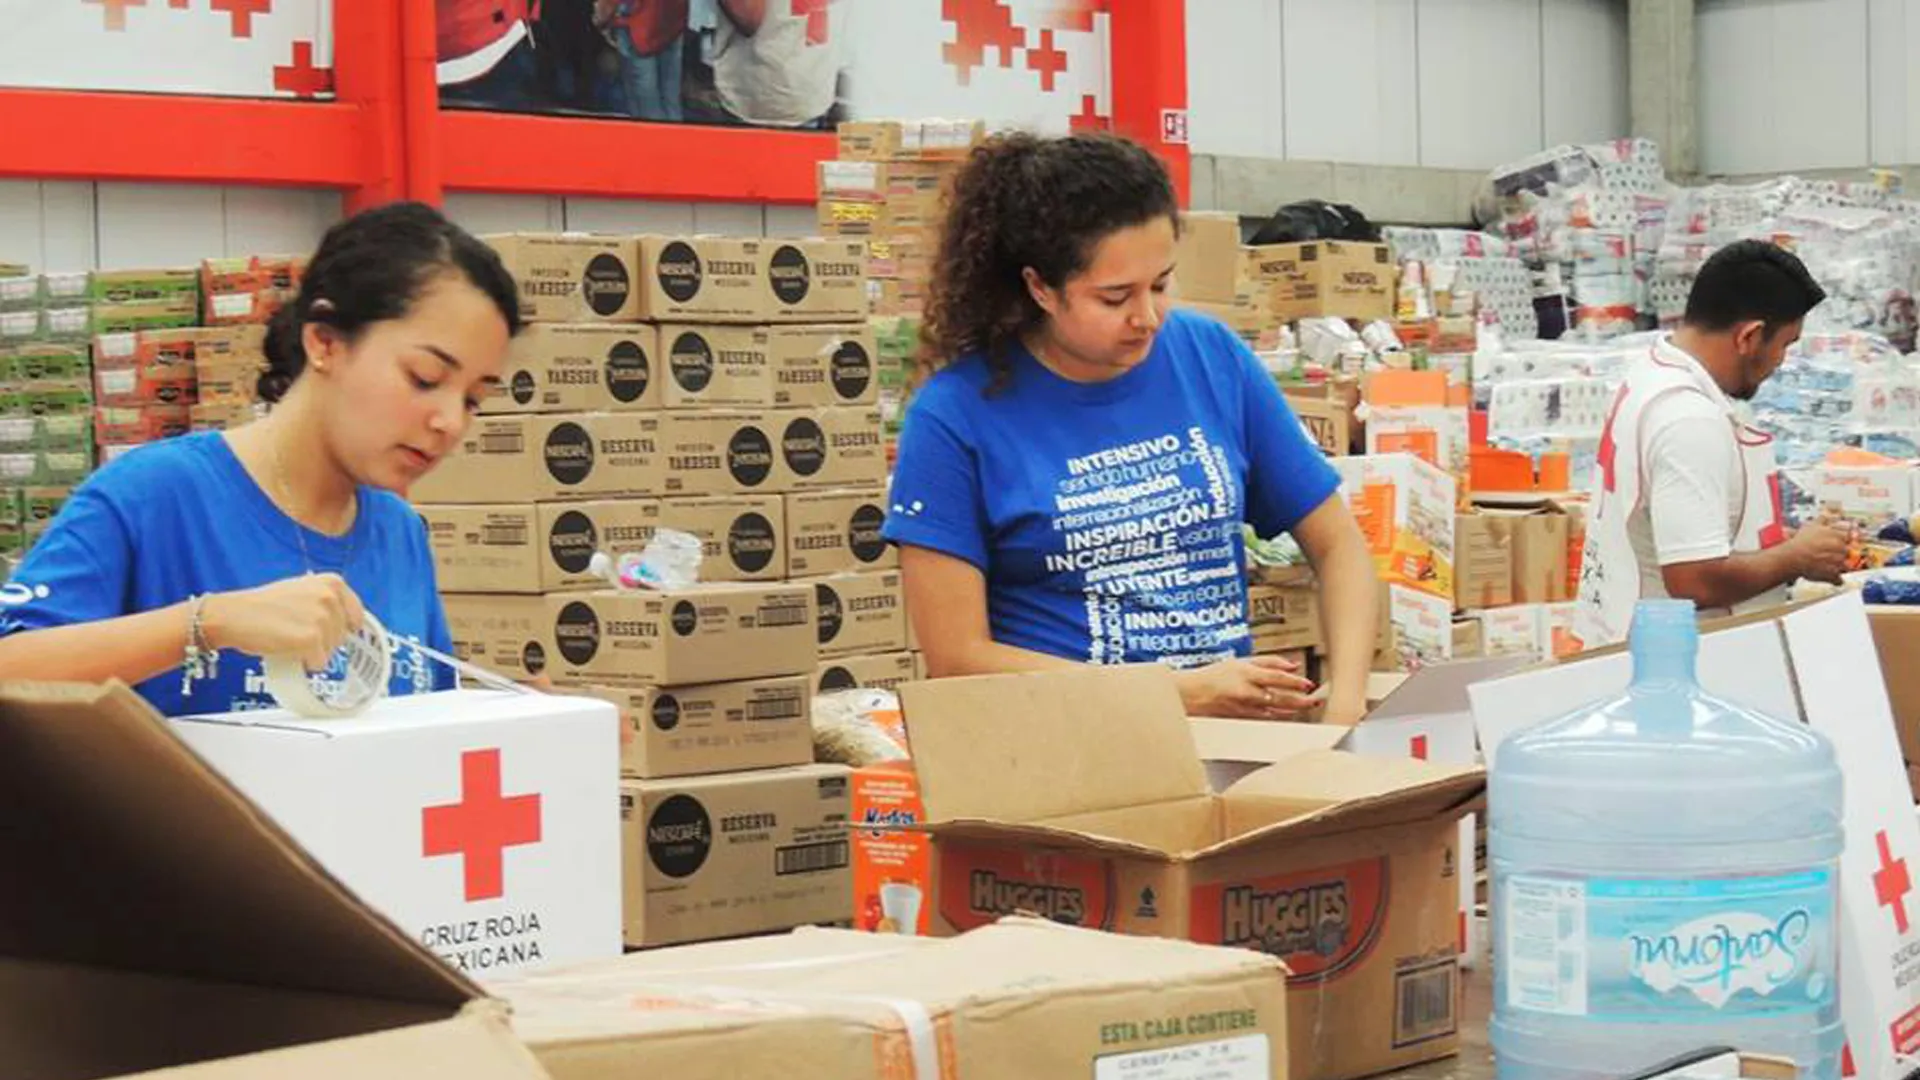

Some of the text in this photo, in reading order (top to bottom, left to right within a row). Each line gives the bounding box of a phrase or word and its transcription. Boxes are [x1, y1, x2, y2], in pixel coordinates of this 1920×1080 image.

[1067, 434, 1180, 475] INTENSIVO
[1055, 473, 1181, 512] investigación
[1065, 501, 1210, 551] INSPIRACIÓN
[720, 813, 777, 833] RESERVA
[422, 912, 541, 948] CRUZ ROJA
[1223, 881, 1347, 945] HUGGIES
[442, 941, 542, 970] XICANA
[1628, 906, 1810, 990] Santorini
[1101, 1008, 1257, 1044] ESTA CAJA CONTIENE
